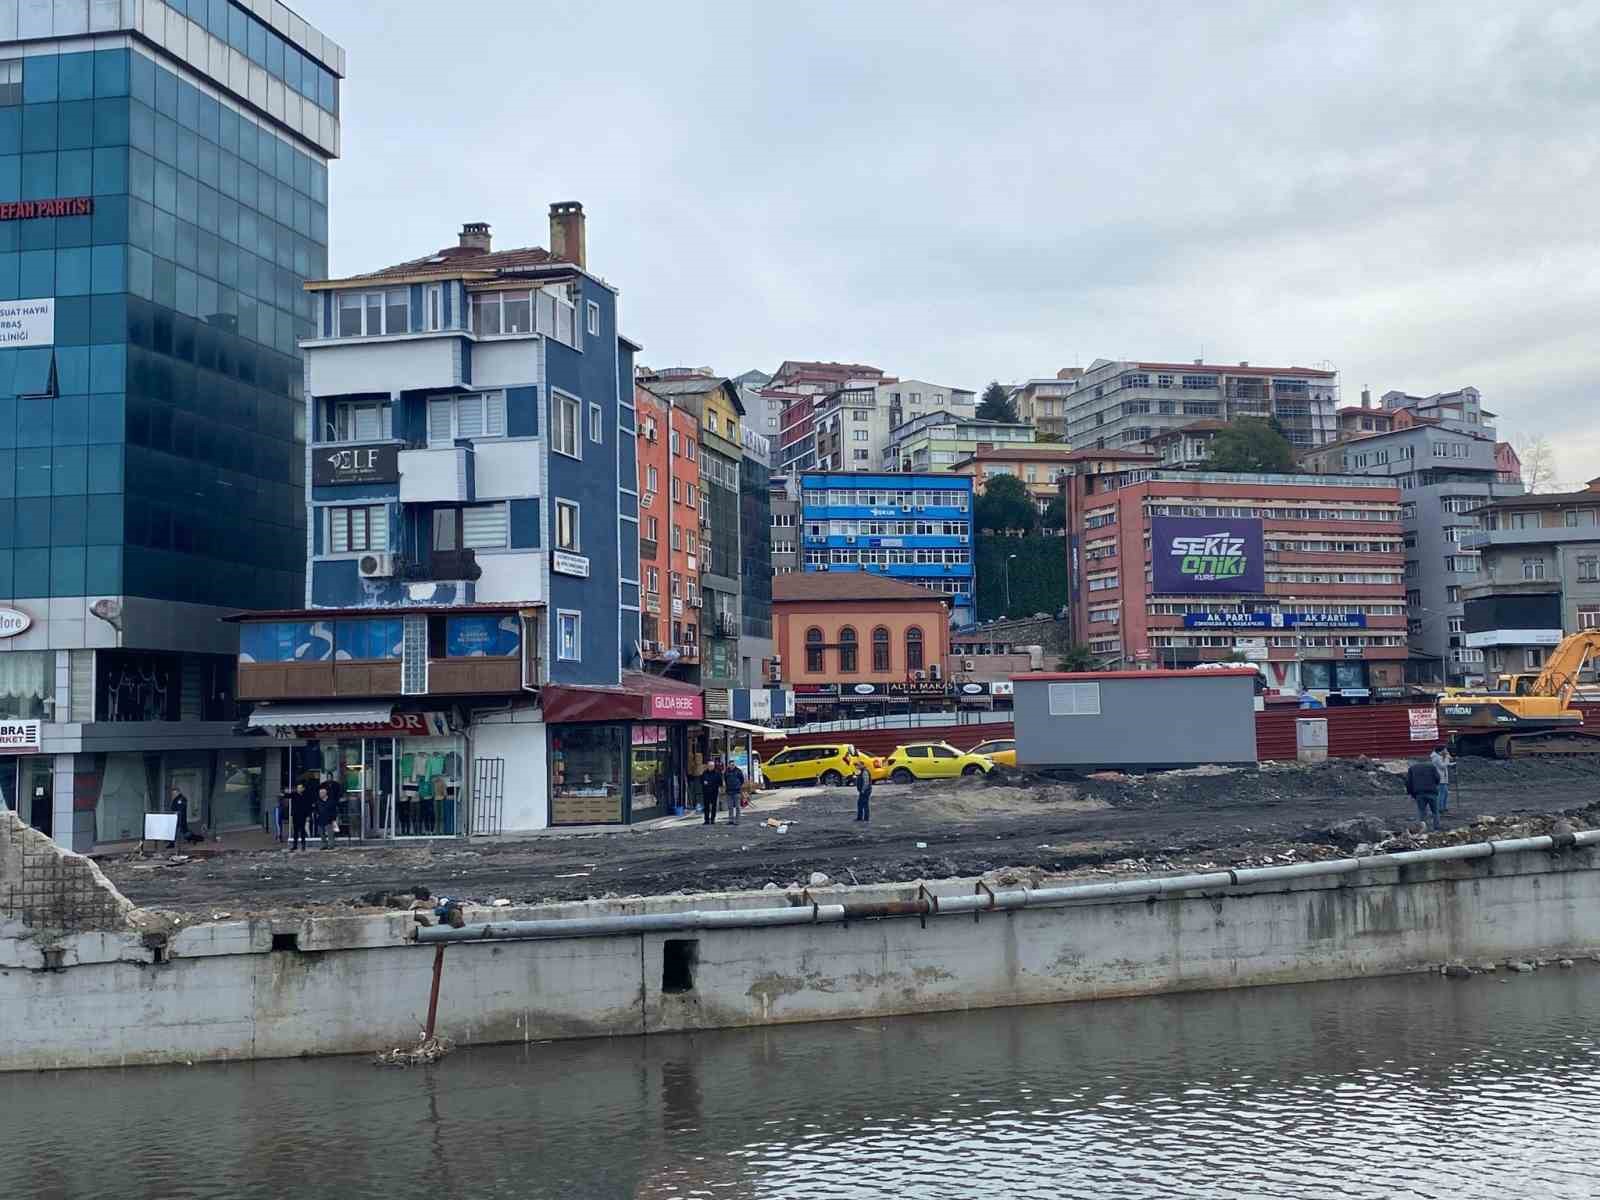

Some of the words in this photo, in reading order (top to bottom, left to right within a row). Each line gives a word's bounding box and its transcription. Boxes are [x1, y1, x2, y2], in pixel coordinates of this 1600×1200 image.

[1170, 532, 1245, 556] SEKİZ
[1207, 613, 1221, 622] AK
[1305, 614, 1319, 622] AK
